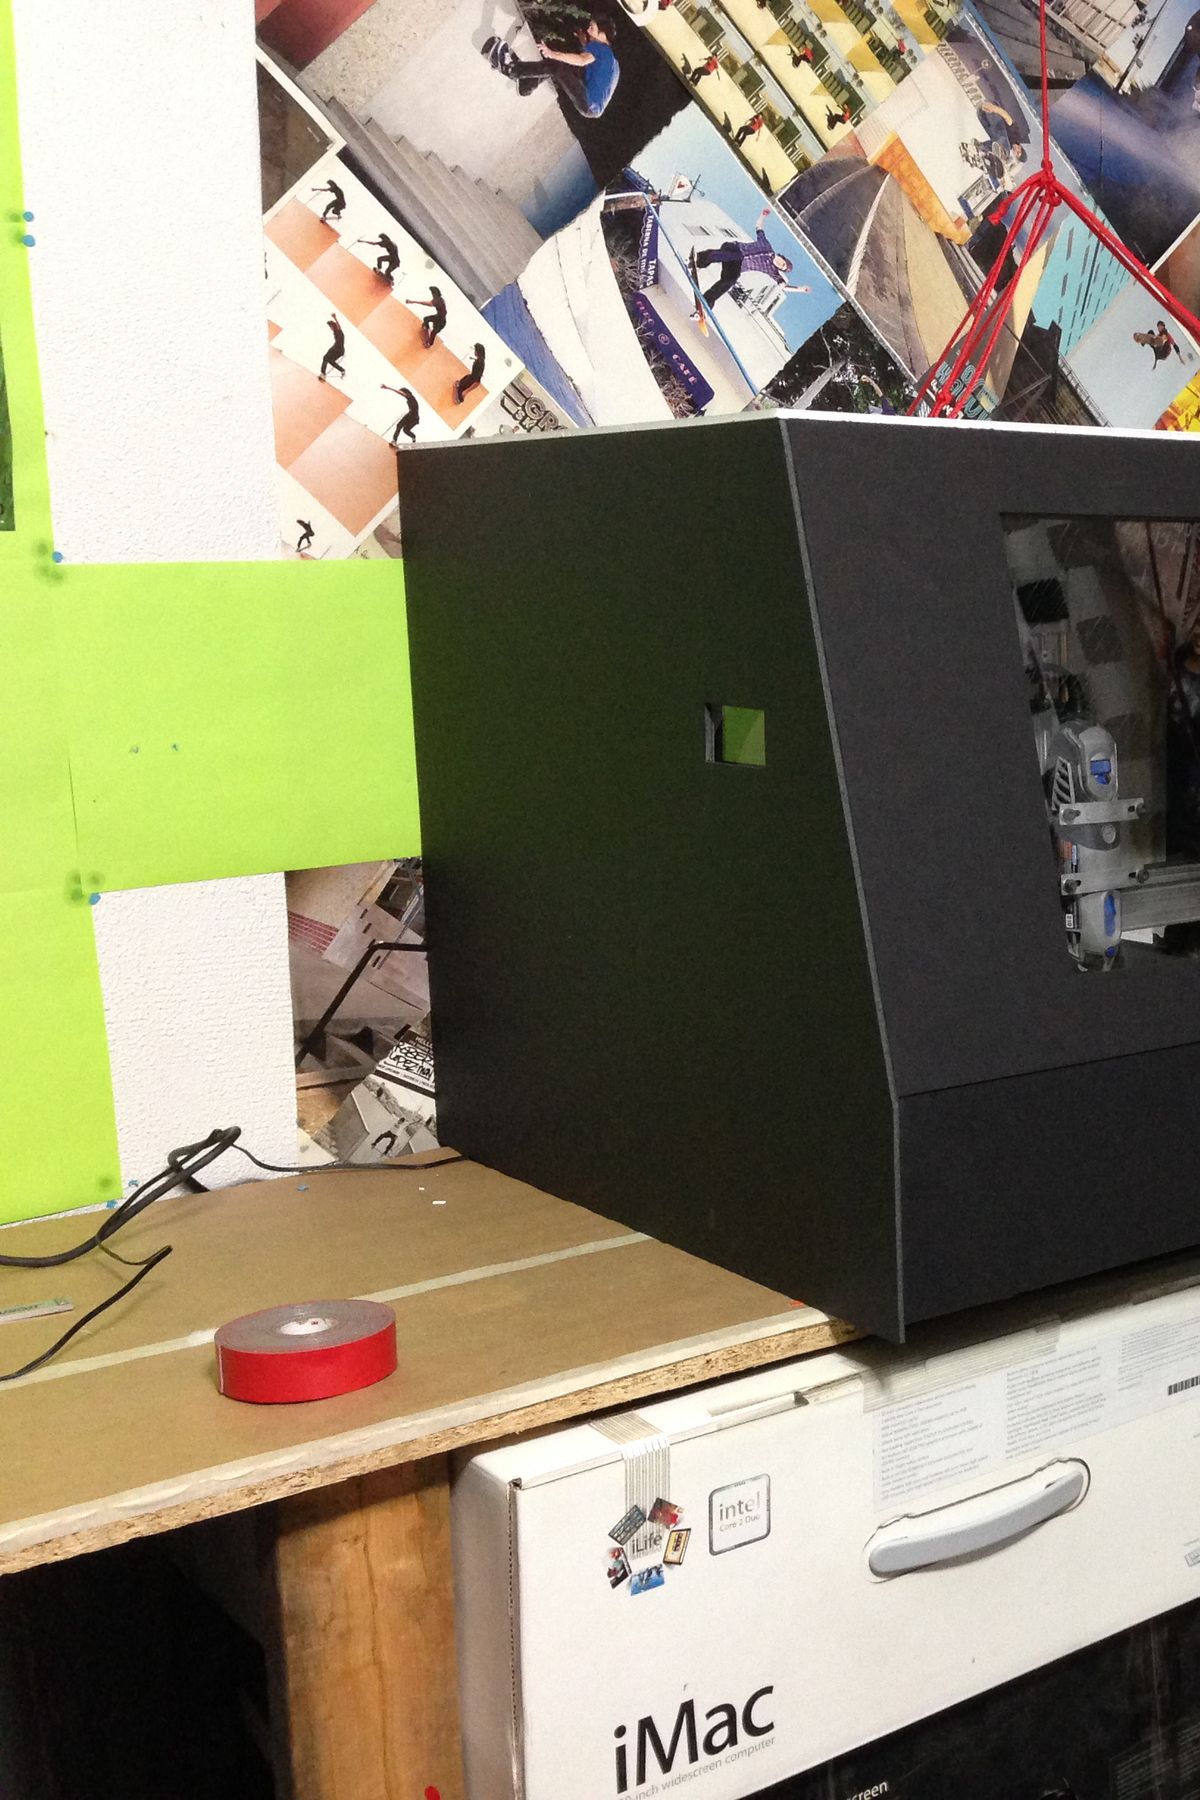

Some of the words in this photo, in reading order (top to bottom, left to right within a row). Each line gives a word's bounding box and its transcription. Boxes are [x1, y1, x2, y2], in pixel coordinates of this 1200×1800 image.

[719, 1490, 761, 1521] intel
[632, 1532, 663, 1554] iLife
[614, 1685, 775, 1794] iMac
[661, 1758, 722, 1791] widescreen
[724, 1737, 776, 1766] computer
